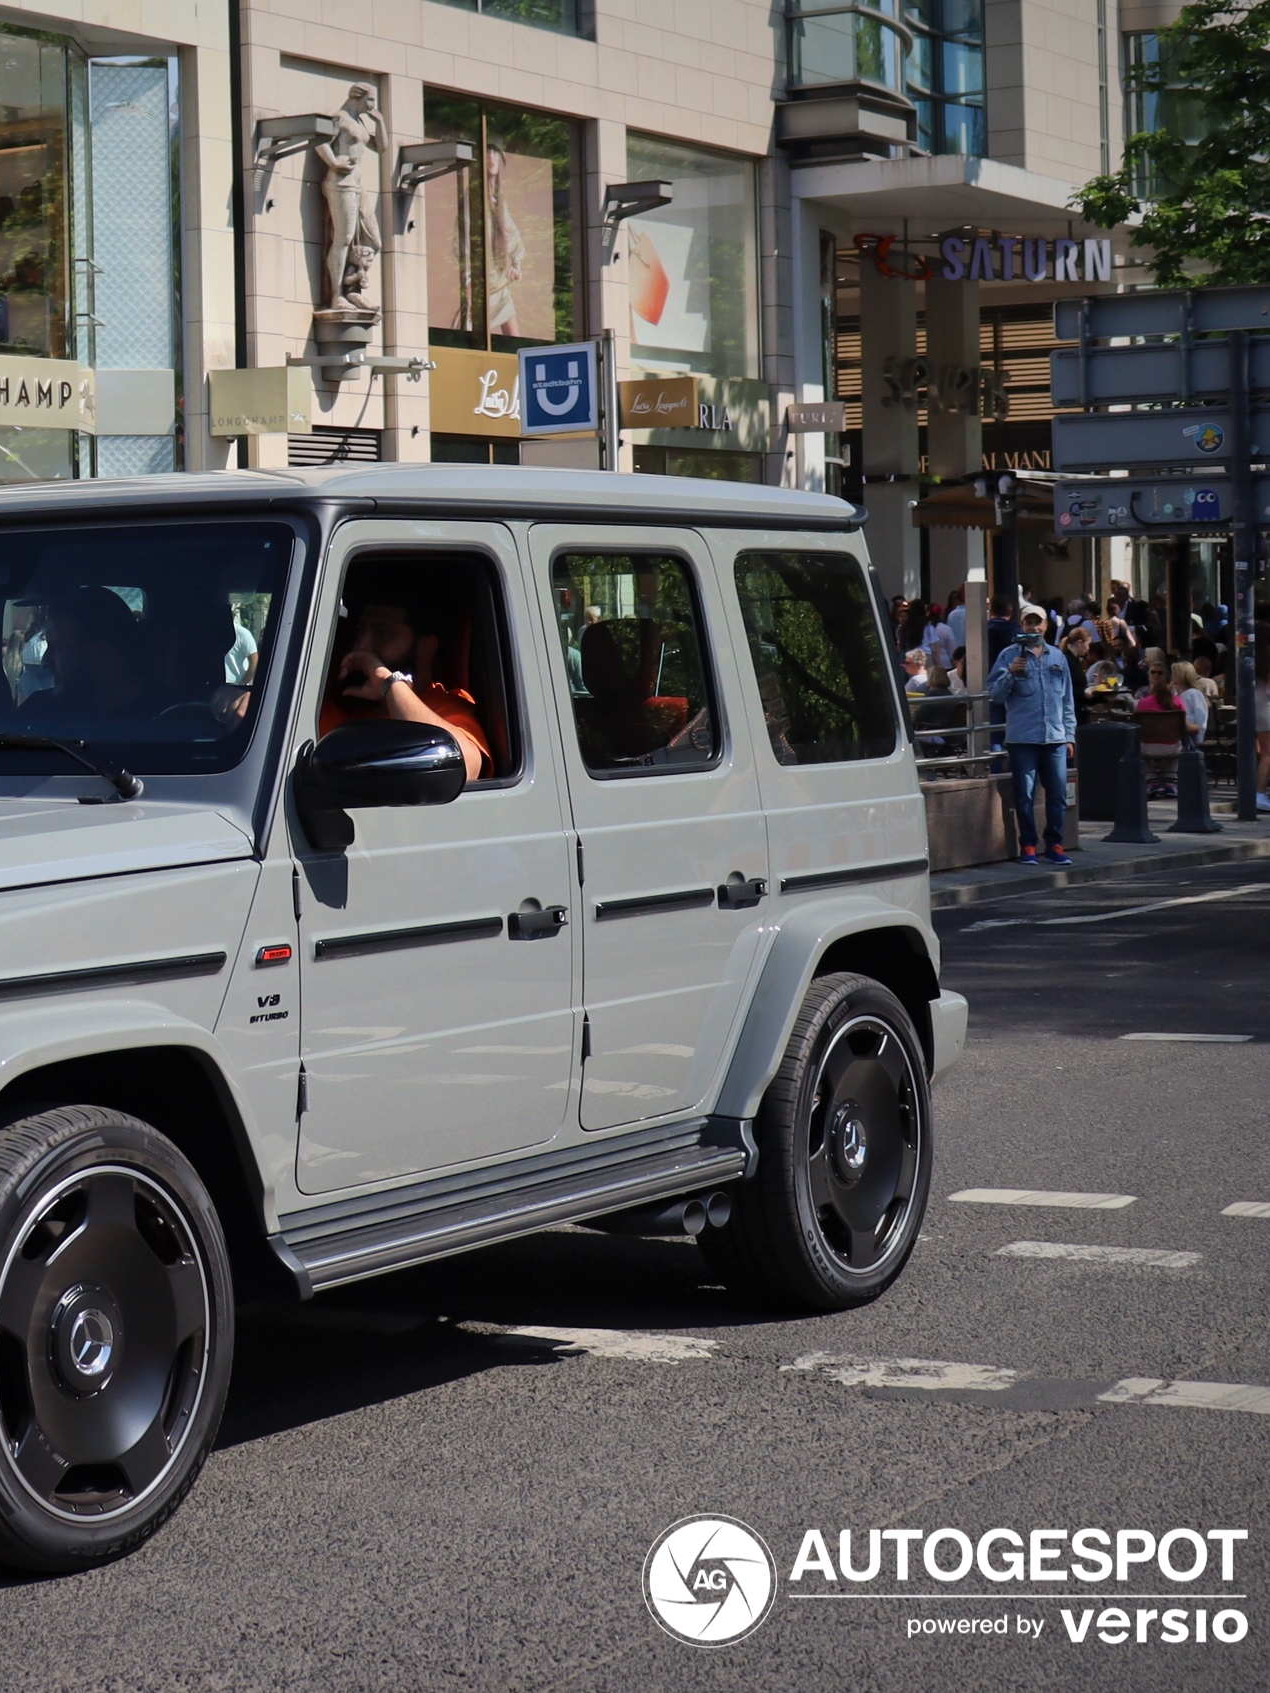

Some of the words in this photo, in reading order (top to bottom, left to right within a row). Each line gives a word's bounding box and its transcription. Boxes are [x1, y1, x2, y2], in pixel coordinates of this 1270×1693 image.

[941, 237, 1112, 282] SATURN
[532, 378, 583, 389] stadtbahn
[211, 415, 286, 428] LONGCHAMP
[257, 994, 281, 1008] V8
[249, 1011, 289, 1024] BITURBO
